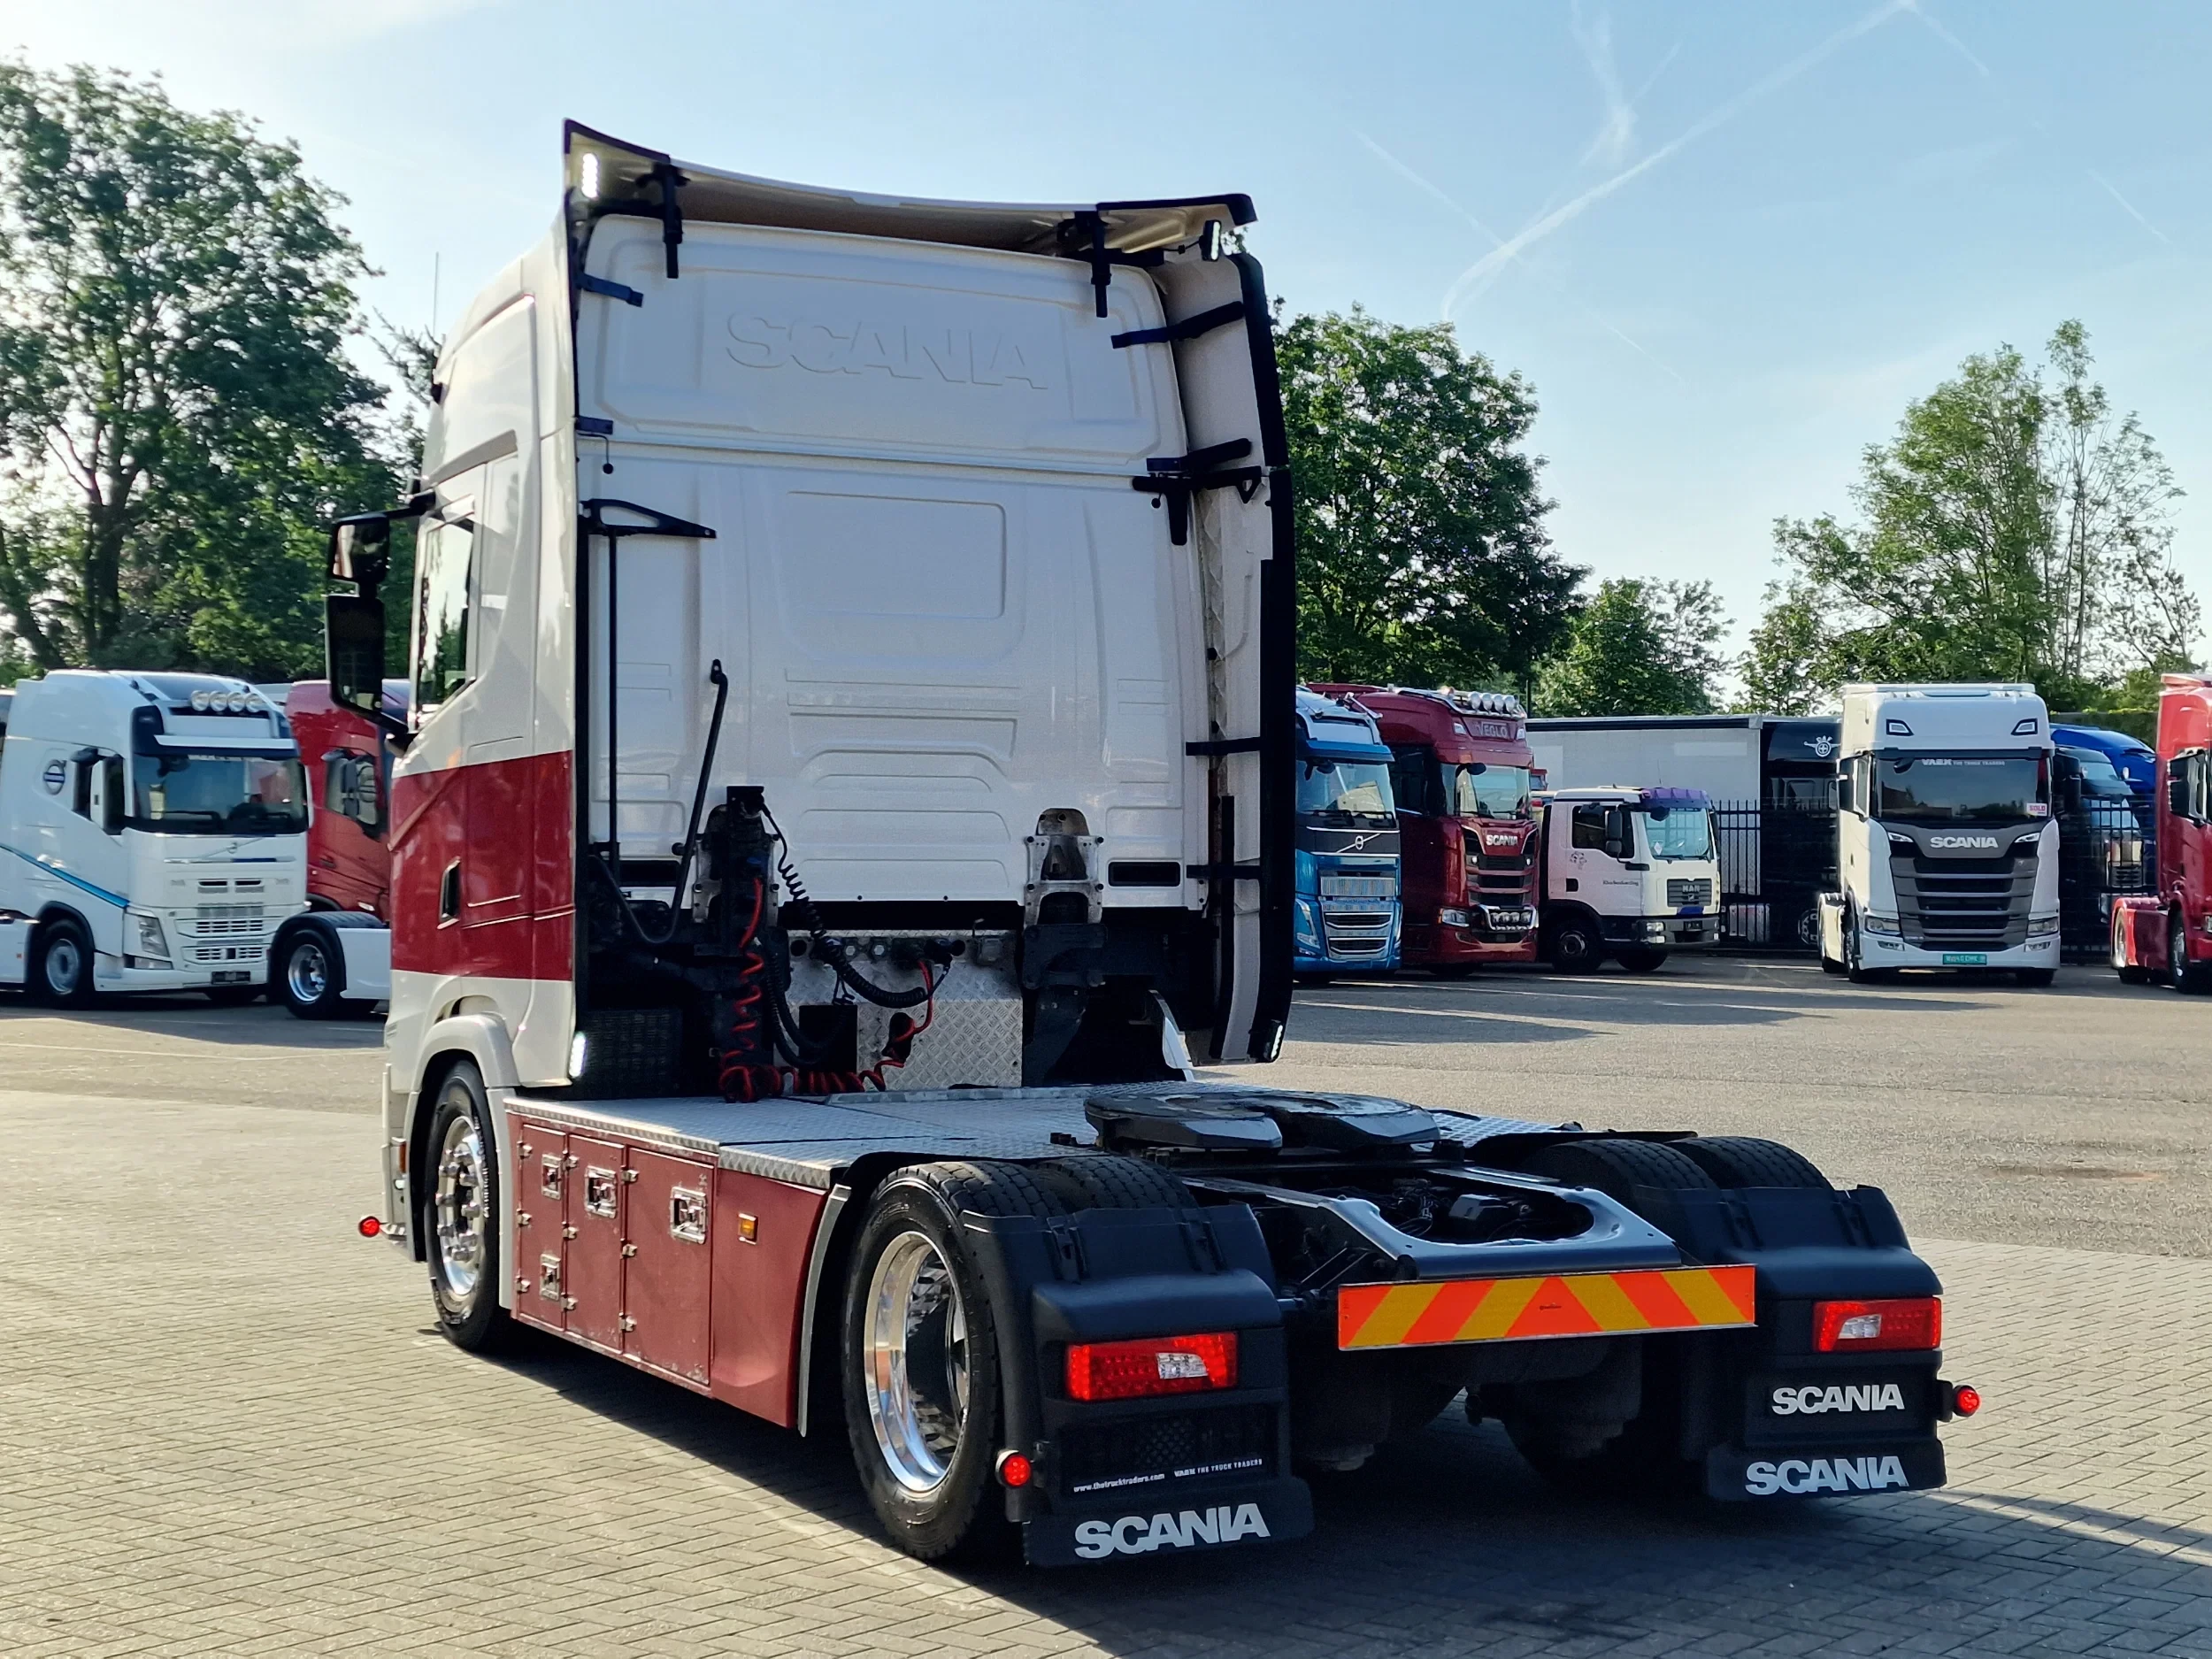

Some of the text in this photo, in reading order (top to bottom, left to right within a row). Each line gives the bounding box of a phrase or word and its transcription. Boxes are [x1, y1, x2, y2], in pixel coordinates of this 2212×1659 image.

[726, 311, 1048, 390] SCANIA
[1486, 834, 1518, 846] SCANIA
[1930, 836, 1999, 849] SCANIA
[1771, 1384, 1905, 1415] SCANIA
[1211, 1463, 1232, 1471] TRUCK
[1233, 1458, 1263, 1469] TRADERS
[1744, 1455, 1909, 1495] SCANIA
[1074, 1503, 1271, 1559] SCANIA
